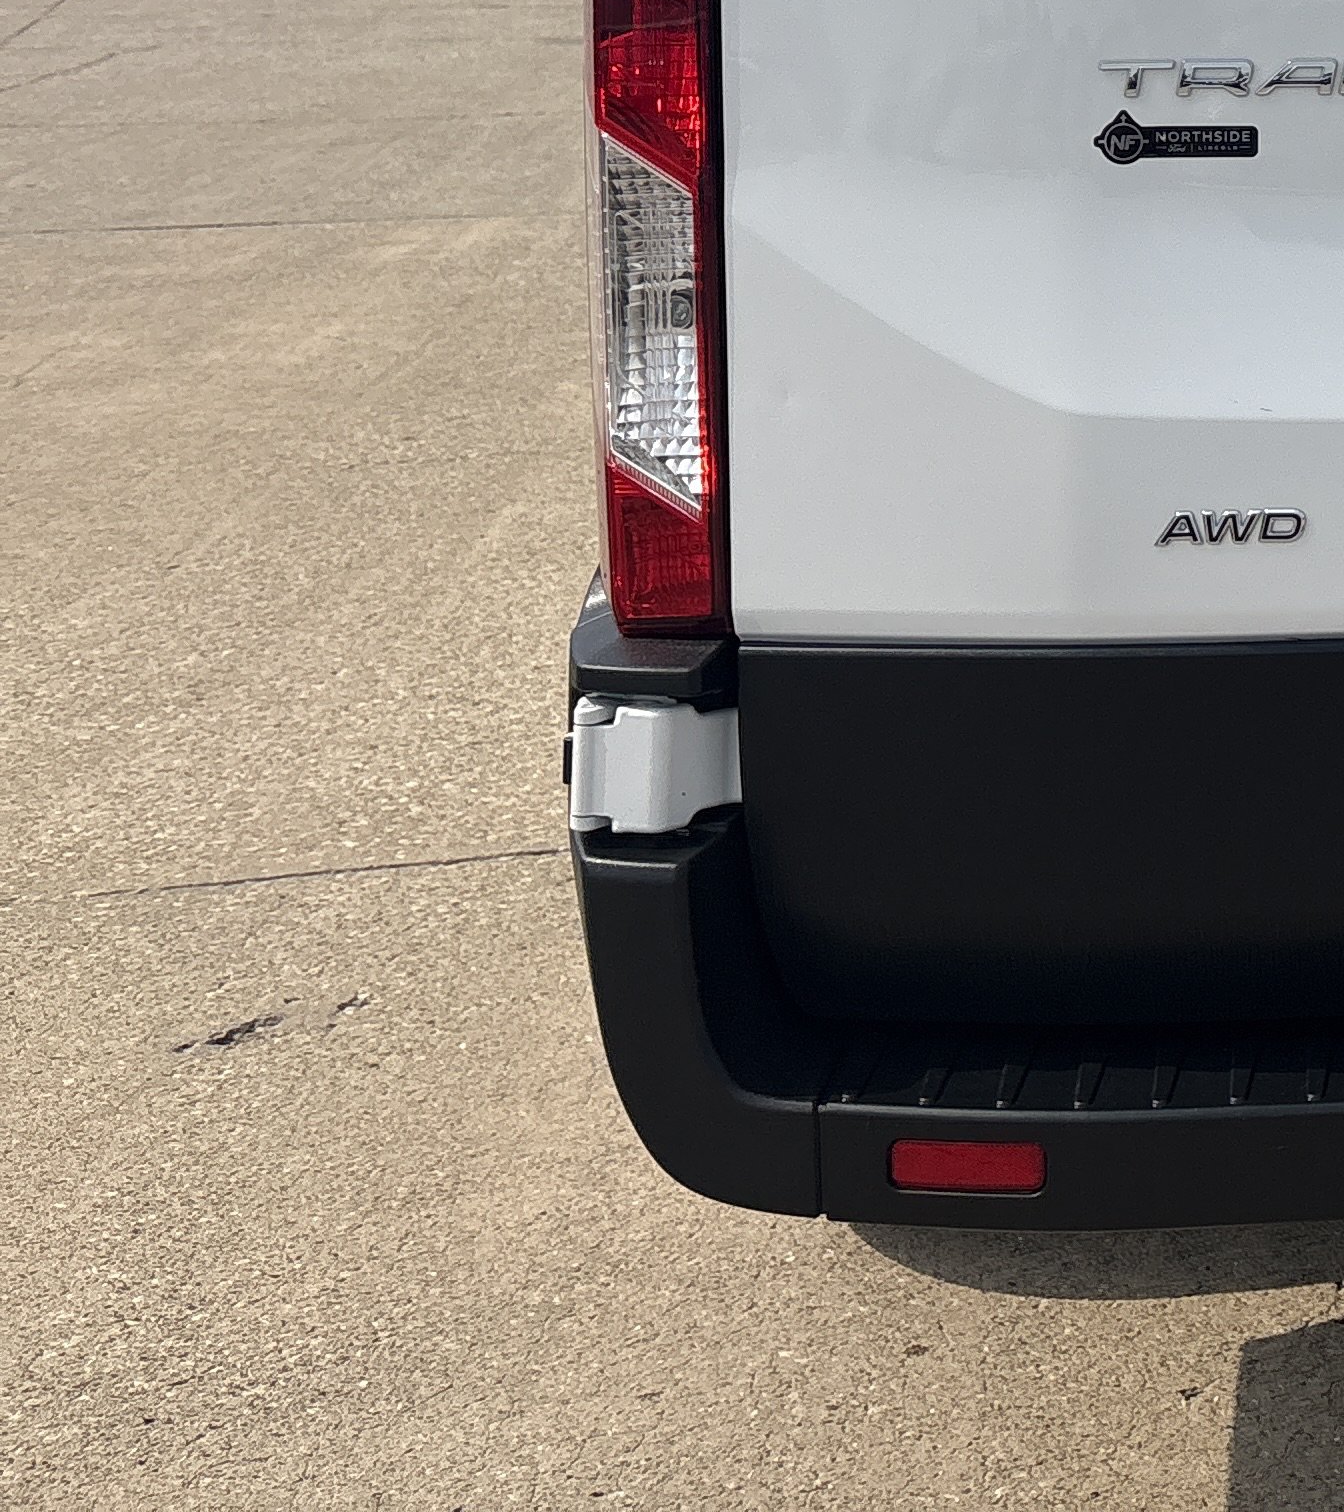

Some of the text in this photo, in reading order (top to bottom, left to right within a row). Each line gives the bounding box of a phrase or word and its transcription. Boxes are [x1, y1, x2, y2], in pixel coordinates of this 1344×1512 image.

[1155, 131, 1251, 143] NORTHSIDE
[1167, 144, 1187, 153] Ford
[1154, 508, 1307, 547] AWD
